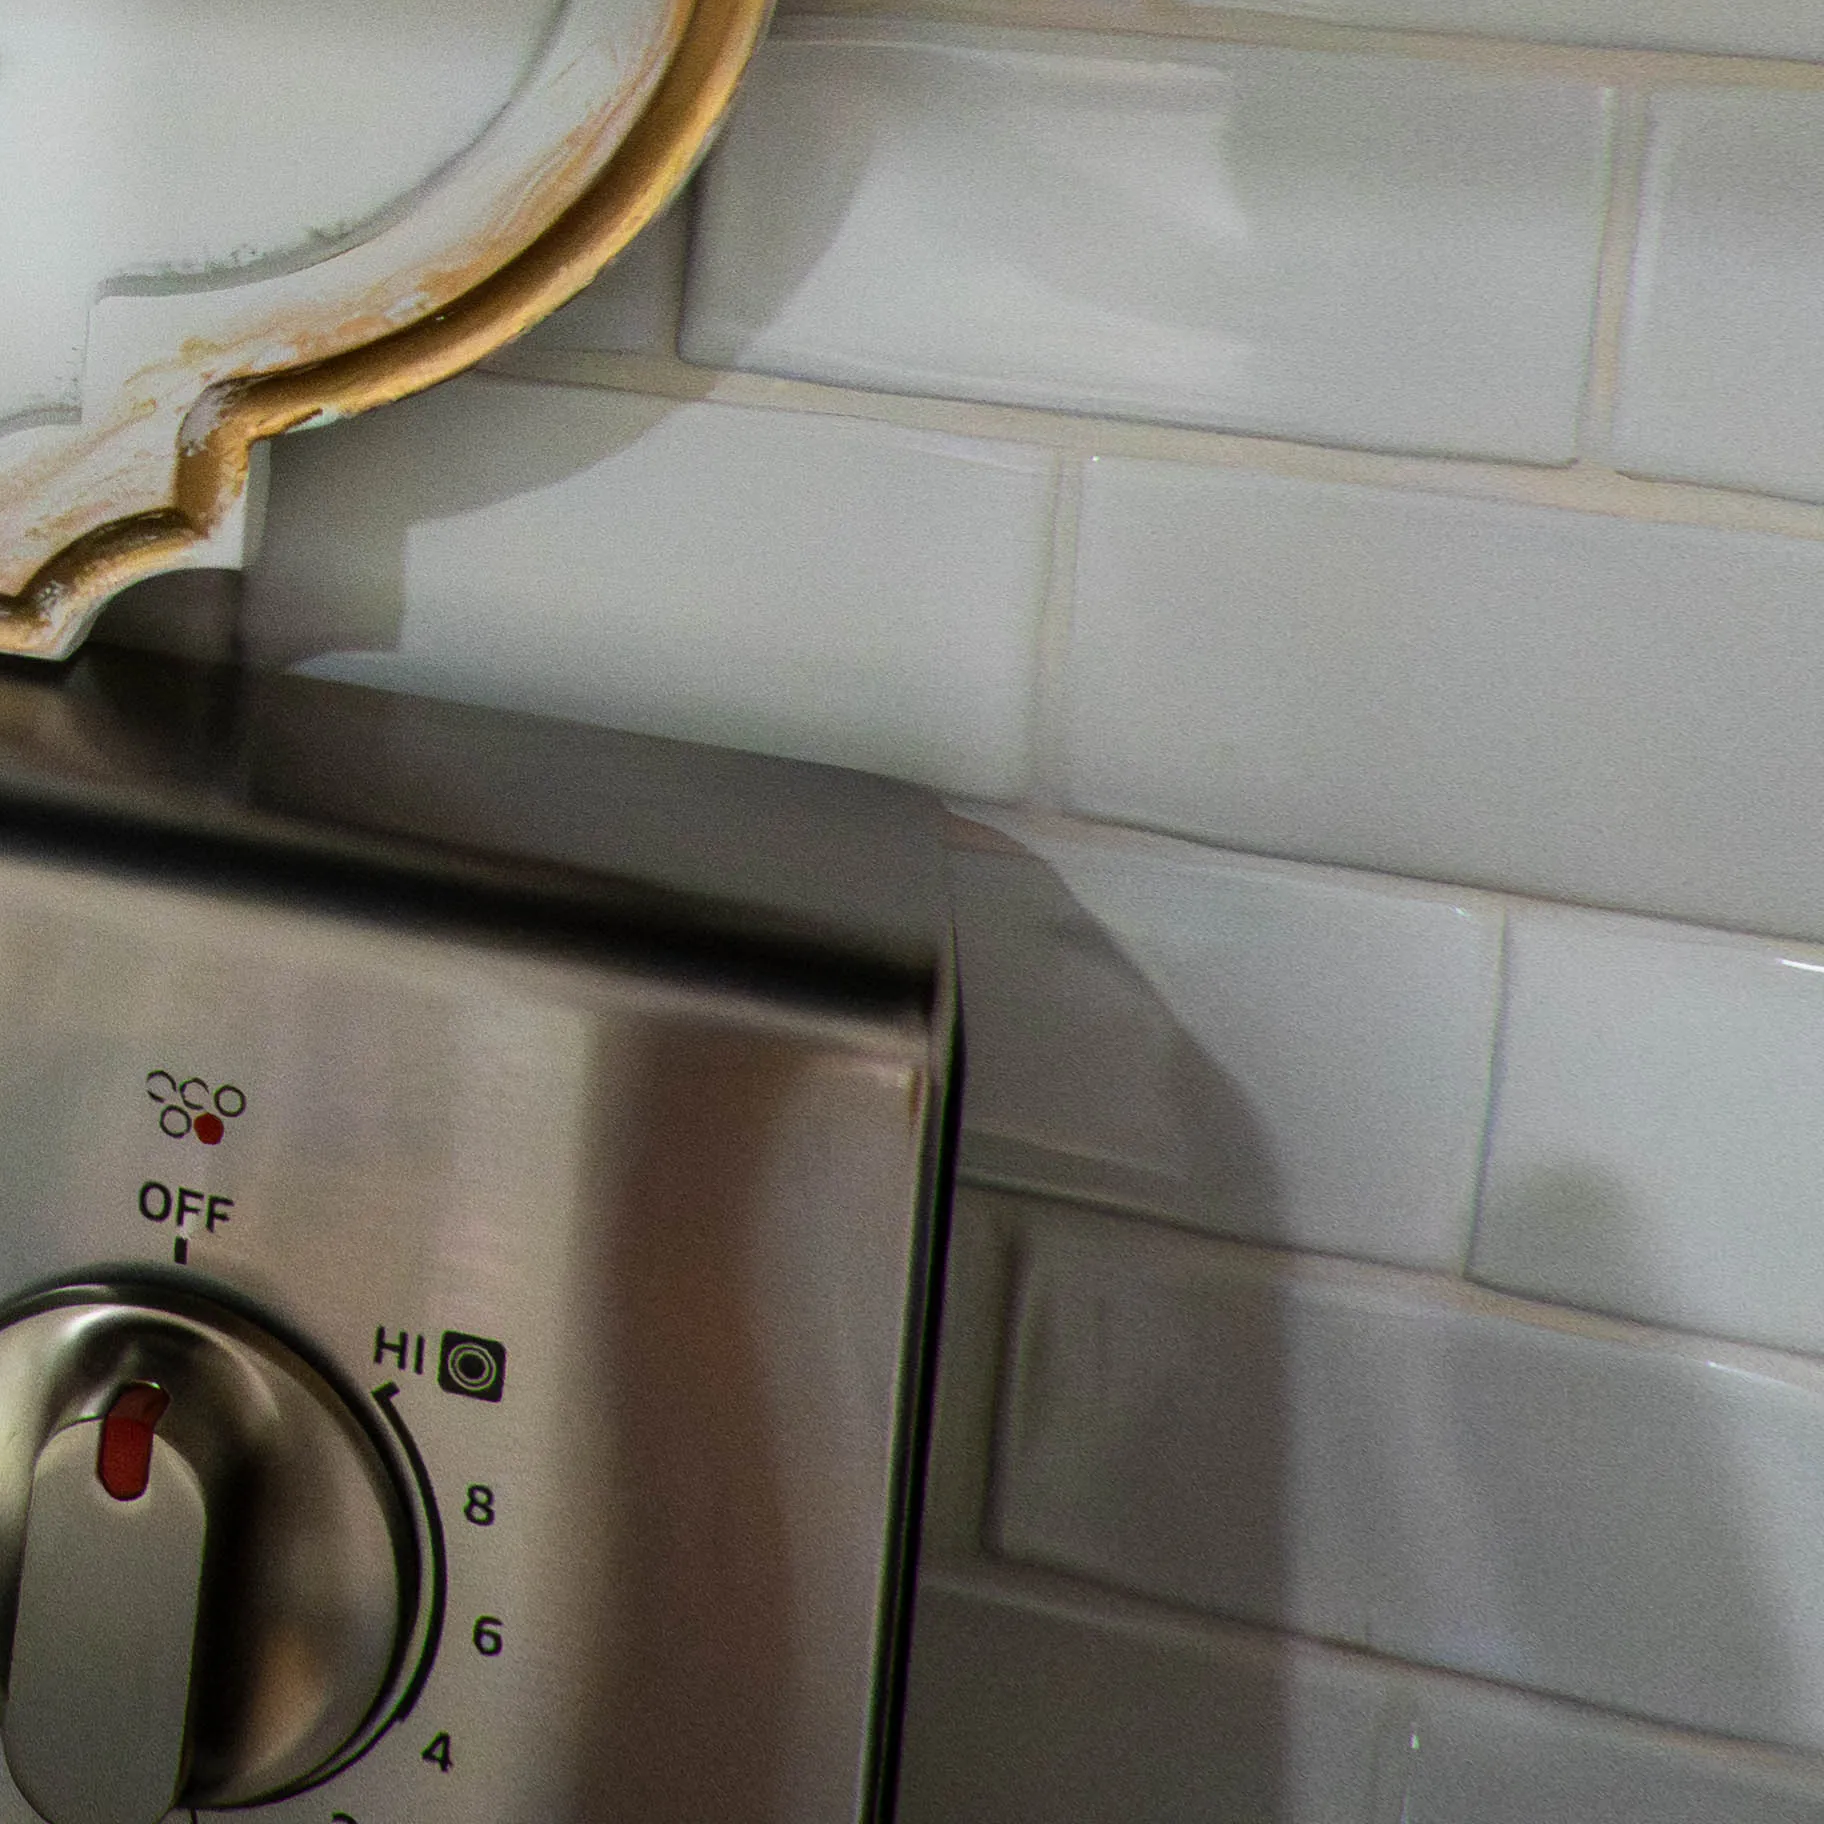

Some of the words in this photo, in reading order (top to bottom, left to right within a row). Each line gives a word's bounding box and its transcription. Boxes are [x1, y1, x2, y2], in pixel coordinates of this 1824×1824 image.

[137, 1181, 235, 1233] OFF
[374, 1325, 426, 1376] HI
[464, 1484, 496, 1527] 8
[472, 1615, 504, 1658] 6
[420, 1730, 453, 1773] 4
